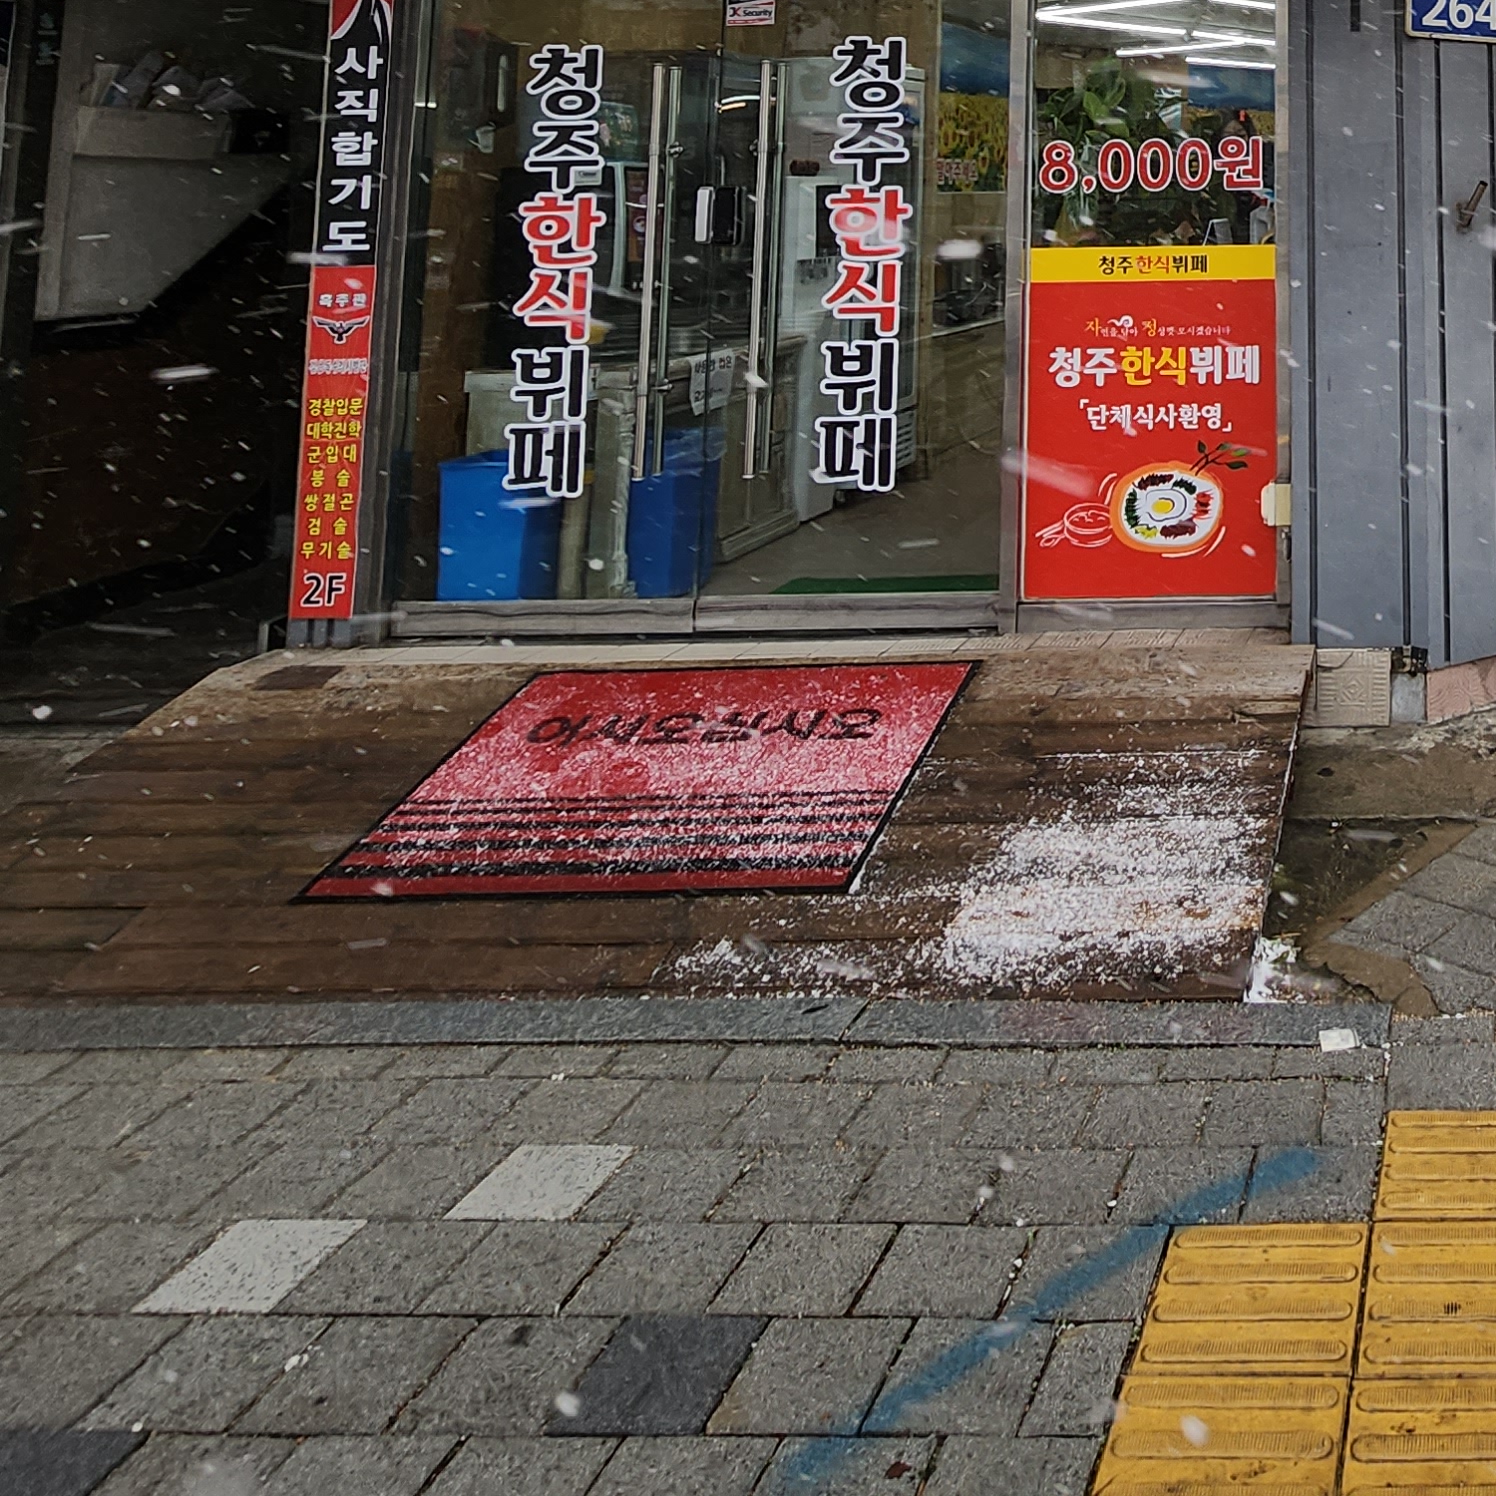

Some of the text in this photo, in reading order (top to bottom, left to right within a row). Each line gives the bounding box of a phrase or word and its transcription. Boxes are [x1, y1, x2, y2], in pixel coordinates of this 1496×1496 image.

[742, 8, 773, 18] Security
[322, 43, 385, 254] 사직합기도
[1038, 135, 1265, 195] 8,000원
[502, 43, 607, 498] 청주한식뷔페
[811, 34, 913, 493] 청주한식뷔페
[1098, 253, 1209, 276] 청주한식뷔페
[1047, 344, 1262, 388] 청주한식뷔페
[307, 397, 364, 418] 경찰입문
[305, 420, 363, 441] 대학진학
[306, 443, 358, 464] 군입대
[303, 492, 355, 513] 쌍절곤
[300, 540, 353, 561] 무기술
[300, 571, 348, 609] 2F
